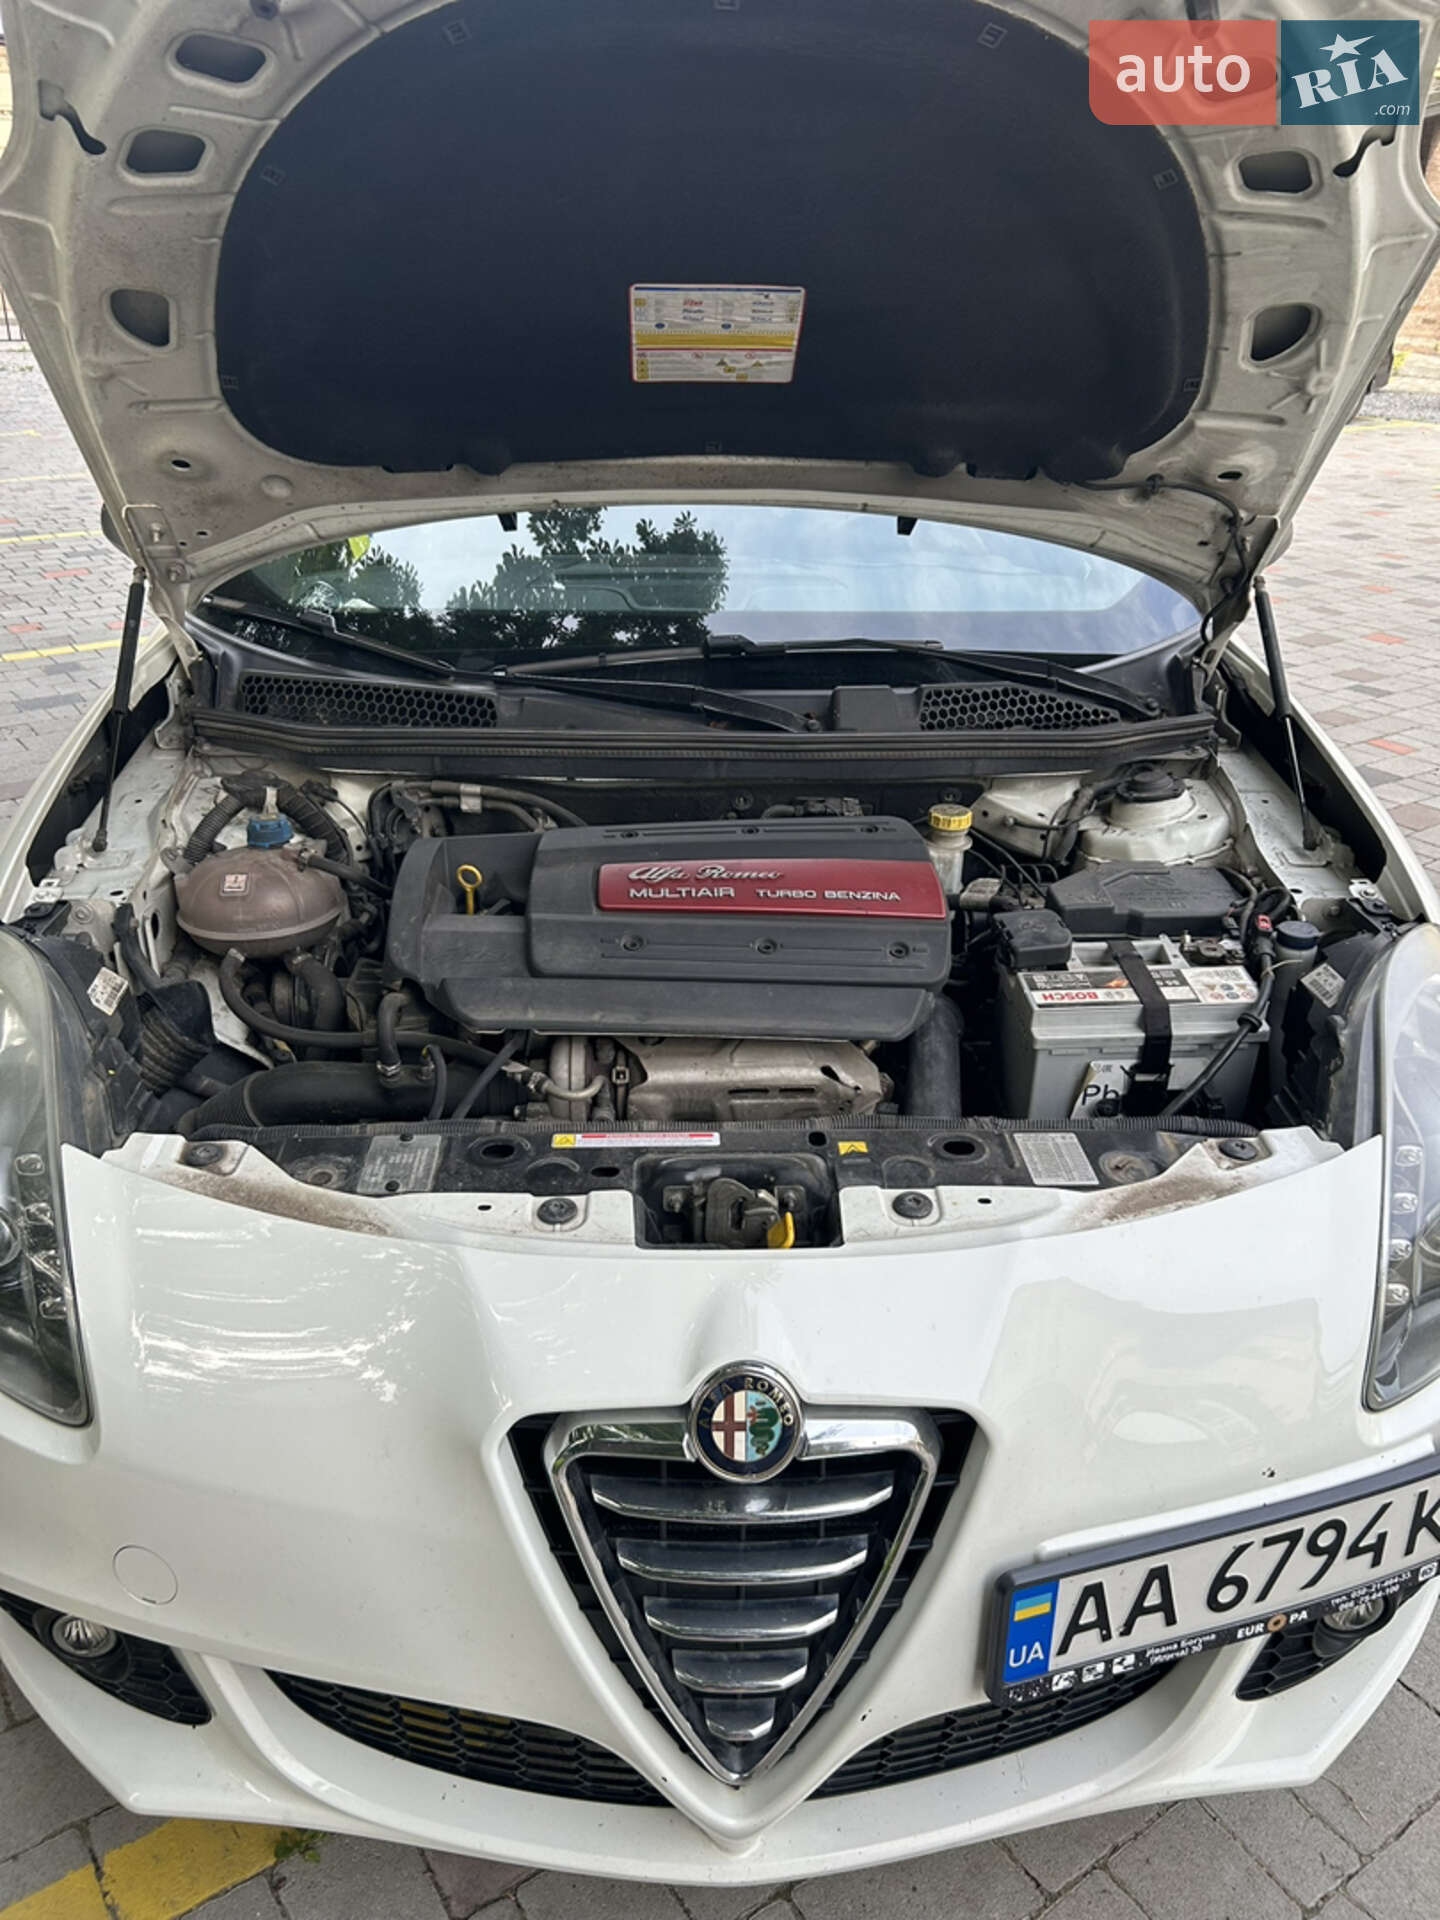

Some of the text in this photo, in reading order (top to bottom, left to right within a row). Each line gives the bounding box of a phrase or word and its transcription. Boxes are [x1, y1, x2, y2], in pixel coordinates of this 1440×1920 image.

[628, 865, 783, 884] Alfa Romeo
[629, 886, 901, 901] MULTIAIR TURBO BENZINA
[1041, 991, 1099, 1001] BOSCH
[744, 1377, 794, 1427] ROMEO
[1205, 1501, 1394, 1613] 6794
[1009, 1641, 1045, 1669] UA
